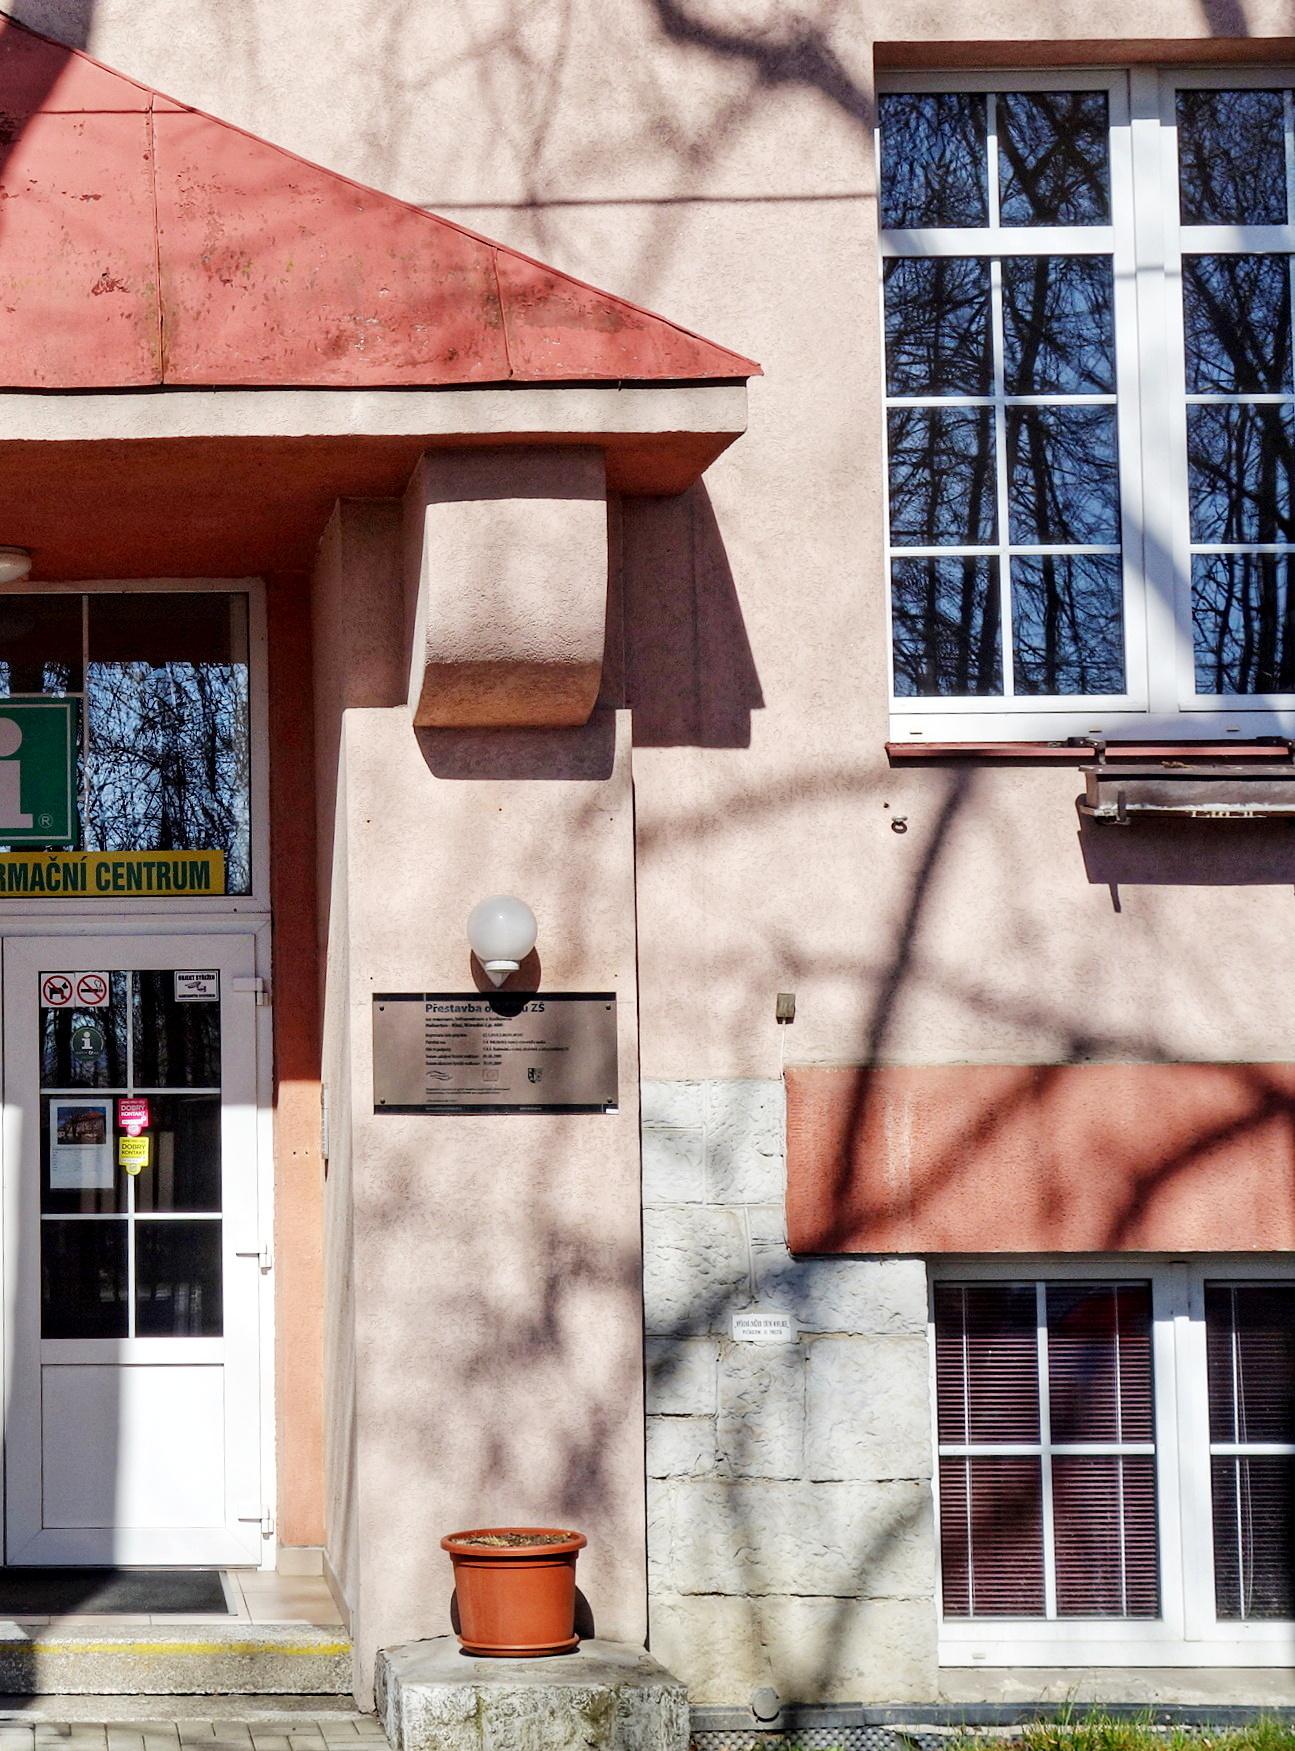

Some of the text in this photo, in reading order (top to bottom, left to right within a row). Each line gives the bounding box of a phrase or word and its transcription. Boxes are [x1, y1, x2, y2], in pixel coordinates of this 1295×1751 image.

[95, 860, 211, 891] CENTRUM
[425, 1003, 482, 1013] Přestavba
[530, 1001, 545, 1013] ZŠ
